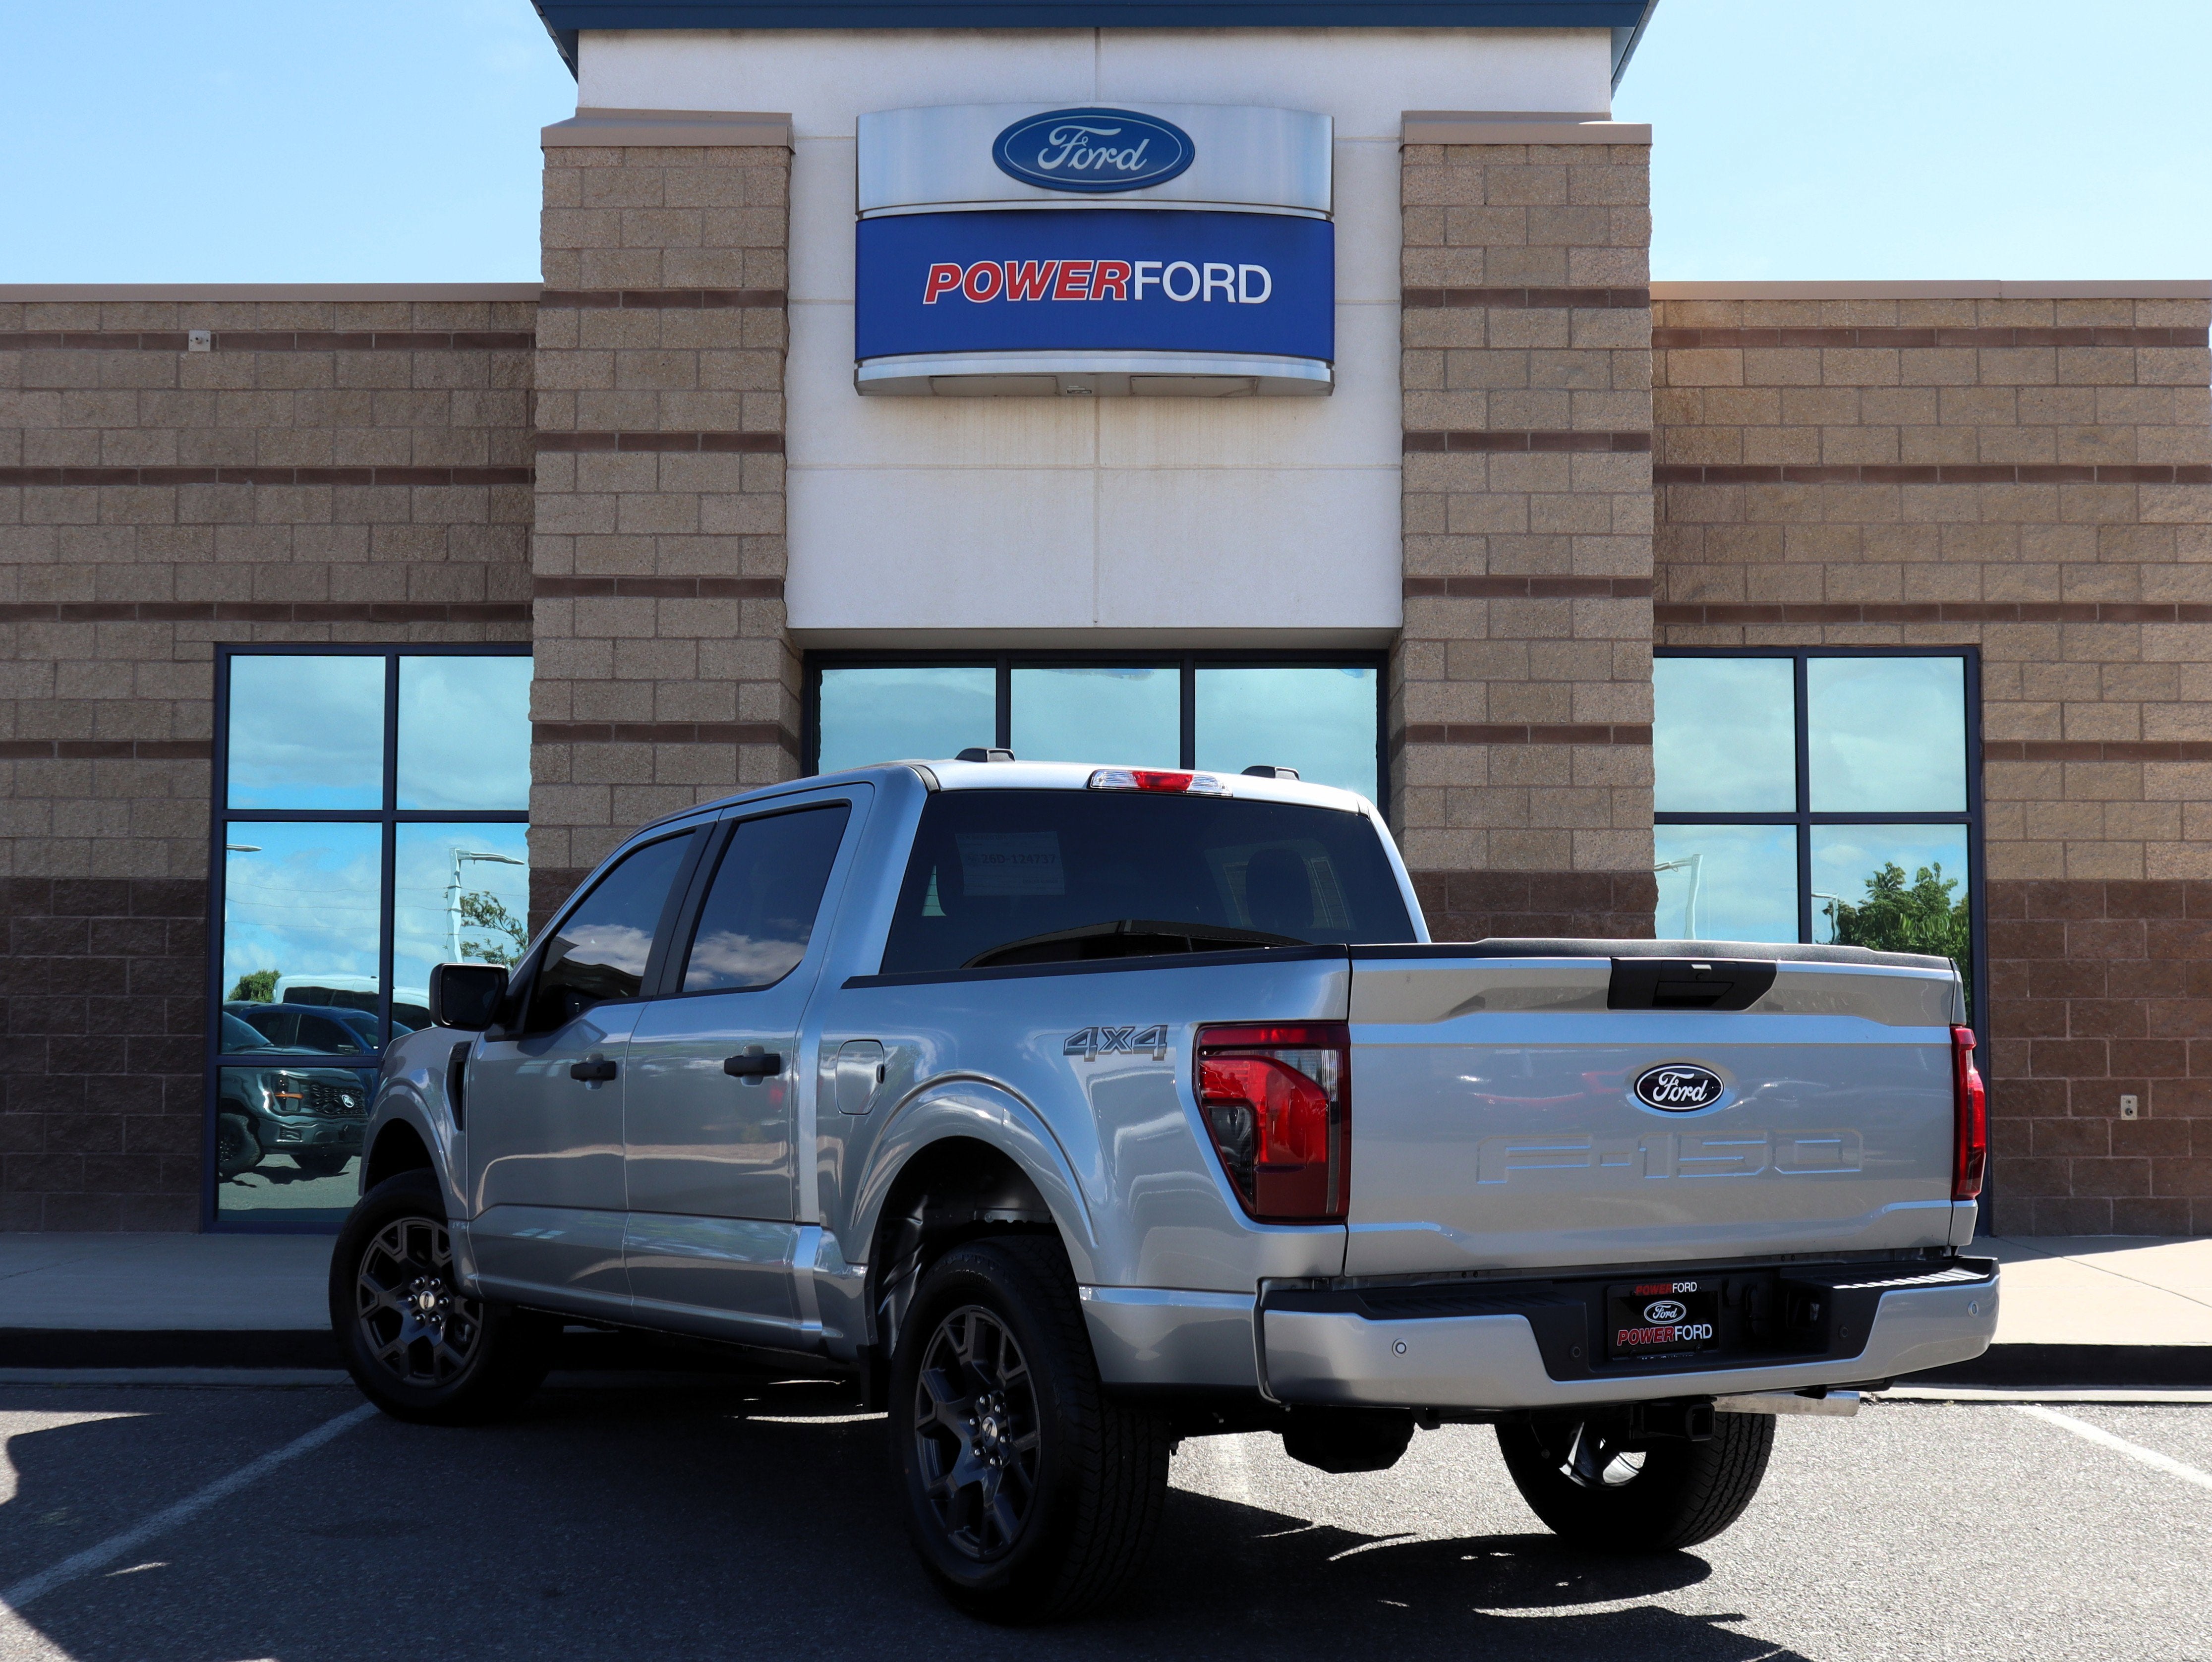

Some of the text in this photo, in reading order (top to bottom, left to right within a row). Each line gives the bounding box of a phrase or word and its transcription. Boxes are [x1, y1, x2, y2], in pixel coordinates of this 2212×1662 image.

[1038, 125, 1150, 171] Ford
[923, 260, 1272, 305] POWERFORD
[1652, 1071, 1708, 1102] Ford
[1477, 1130, 1863, 1184] F-150
[1636, 1281, 1697, 1295] POWERFORD
[1652, 1305, 1678, 1319] Ford
[1617, 1324, 1712, 1346] POWERFORD
